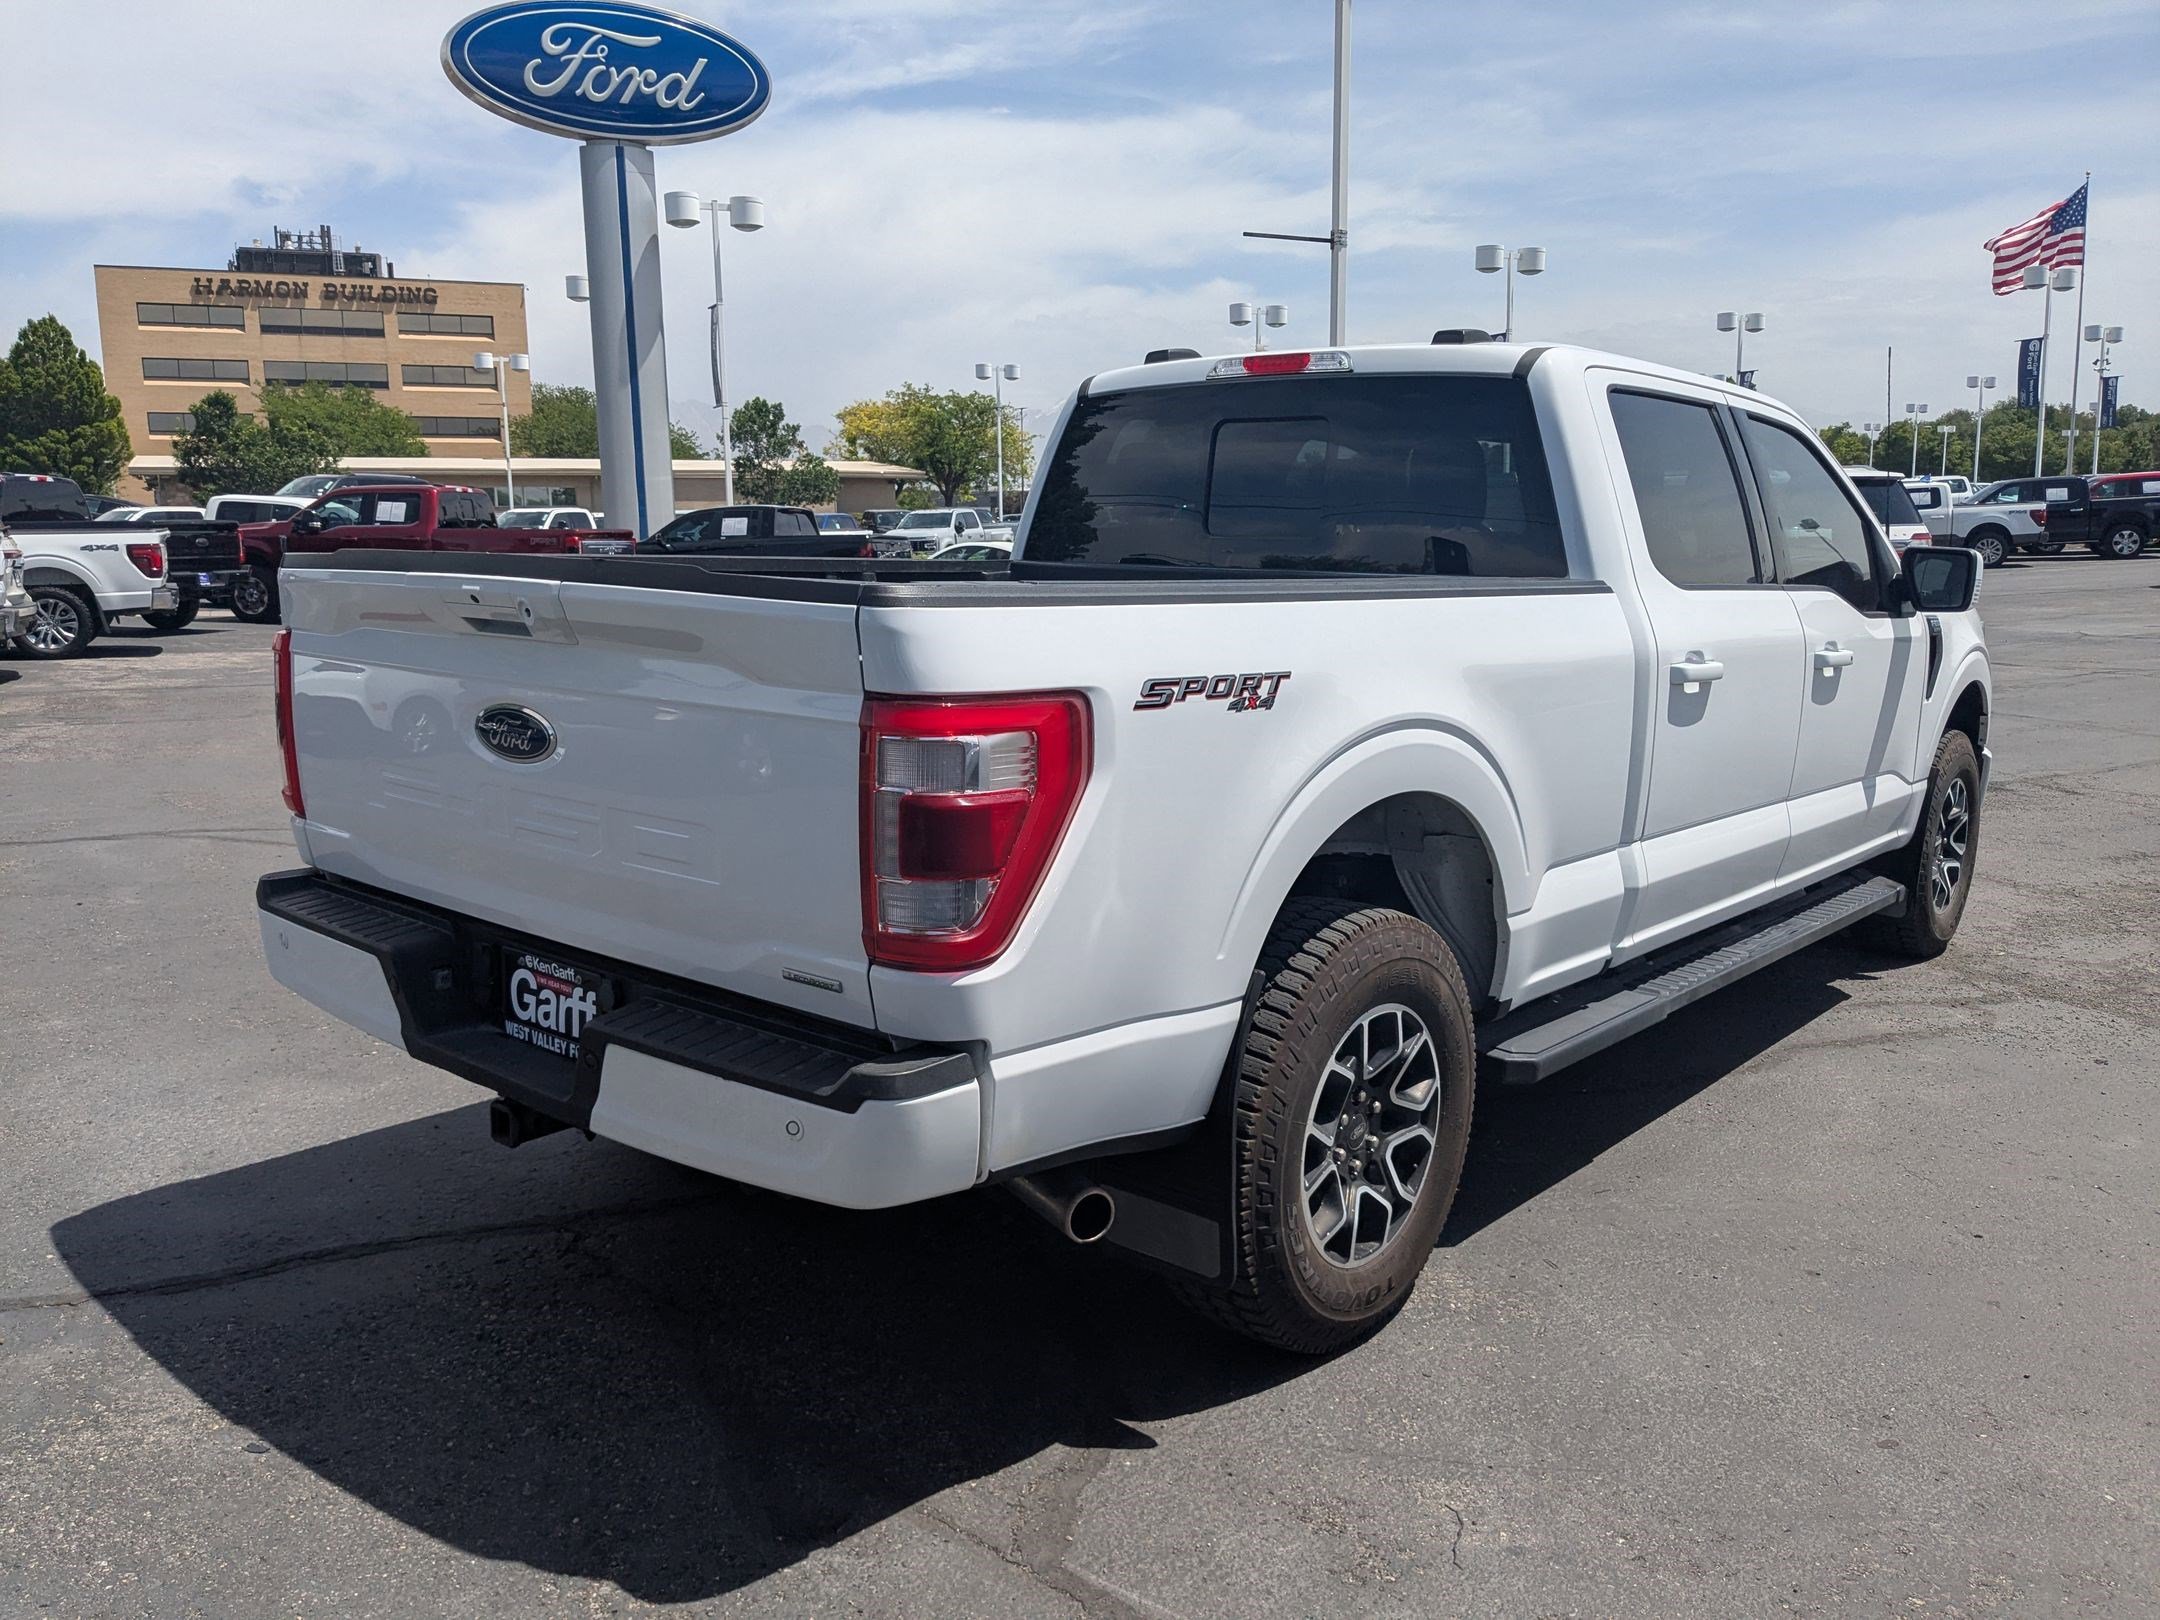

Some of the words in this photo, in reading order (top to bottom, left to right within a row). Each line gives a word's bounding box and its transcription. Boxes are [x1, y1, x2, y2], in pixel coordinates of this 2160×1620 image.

[523, 22, 708, 111] Ford
[193, 277, 309, 299] HARMON
[323, 282, 438, 305] BUILDING
[2026, 351, 2034, 370] Ford
[1133, 671, 1292, 711] SPORT
[489, 715, 532, 751] Ford
[511, 968, 597, 1039] Garff
[505, 1019, 530, 1042] WEST
[532, 1030, 567, 1055] VALLEY
